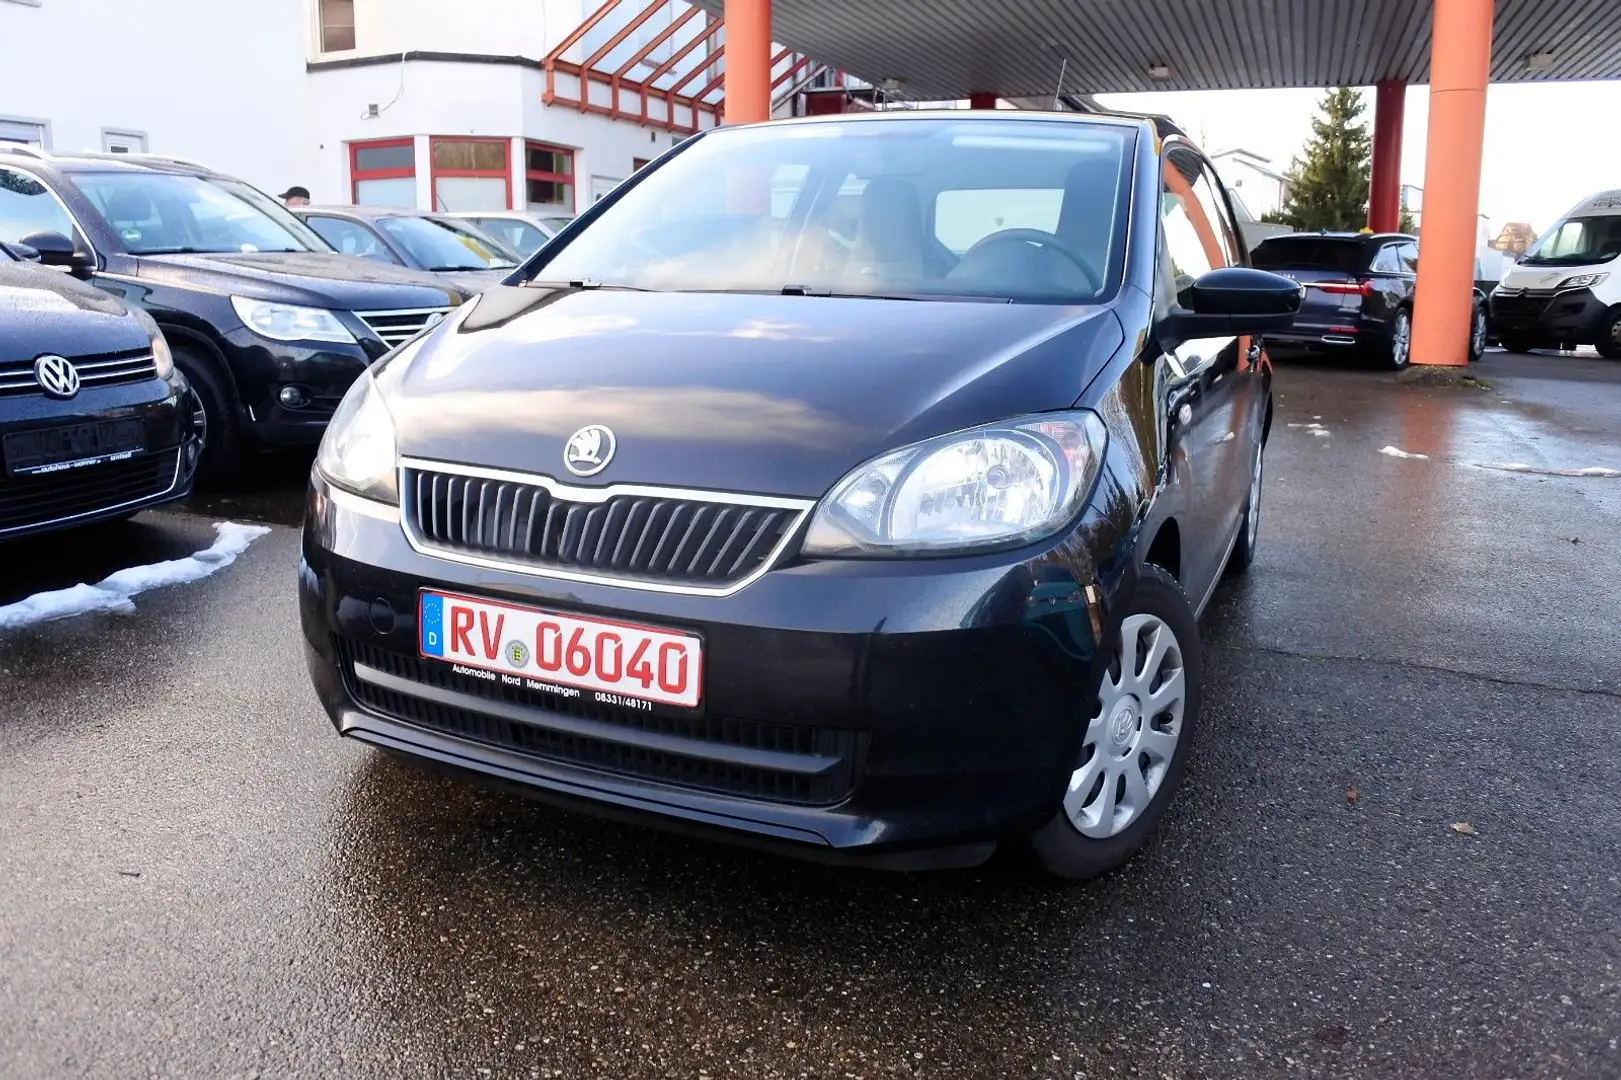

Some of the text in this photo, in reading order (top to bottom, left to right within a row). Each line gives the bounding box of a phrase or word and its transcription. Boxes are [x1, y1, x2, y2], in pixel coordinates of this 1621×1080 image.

[38, 354, 80, 395] VW
[429, 632, 437, 646] D
[451, 605, 504, 660] RV
[536, 621, 687, 693] 06040
[452, 664, 652, 711] Automobile Nord Memmingen 08331/48171
